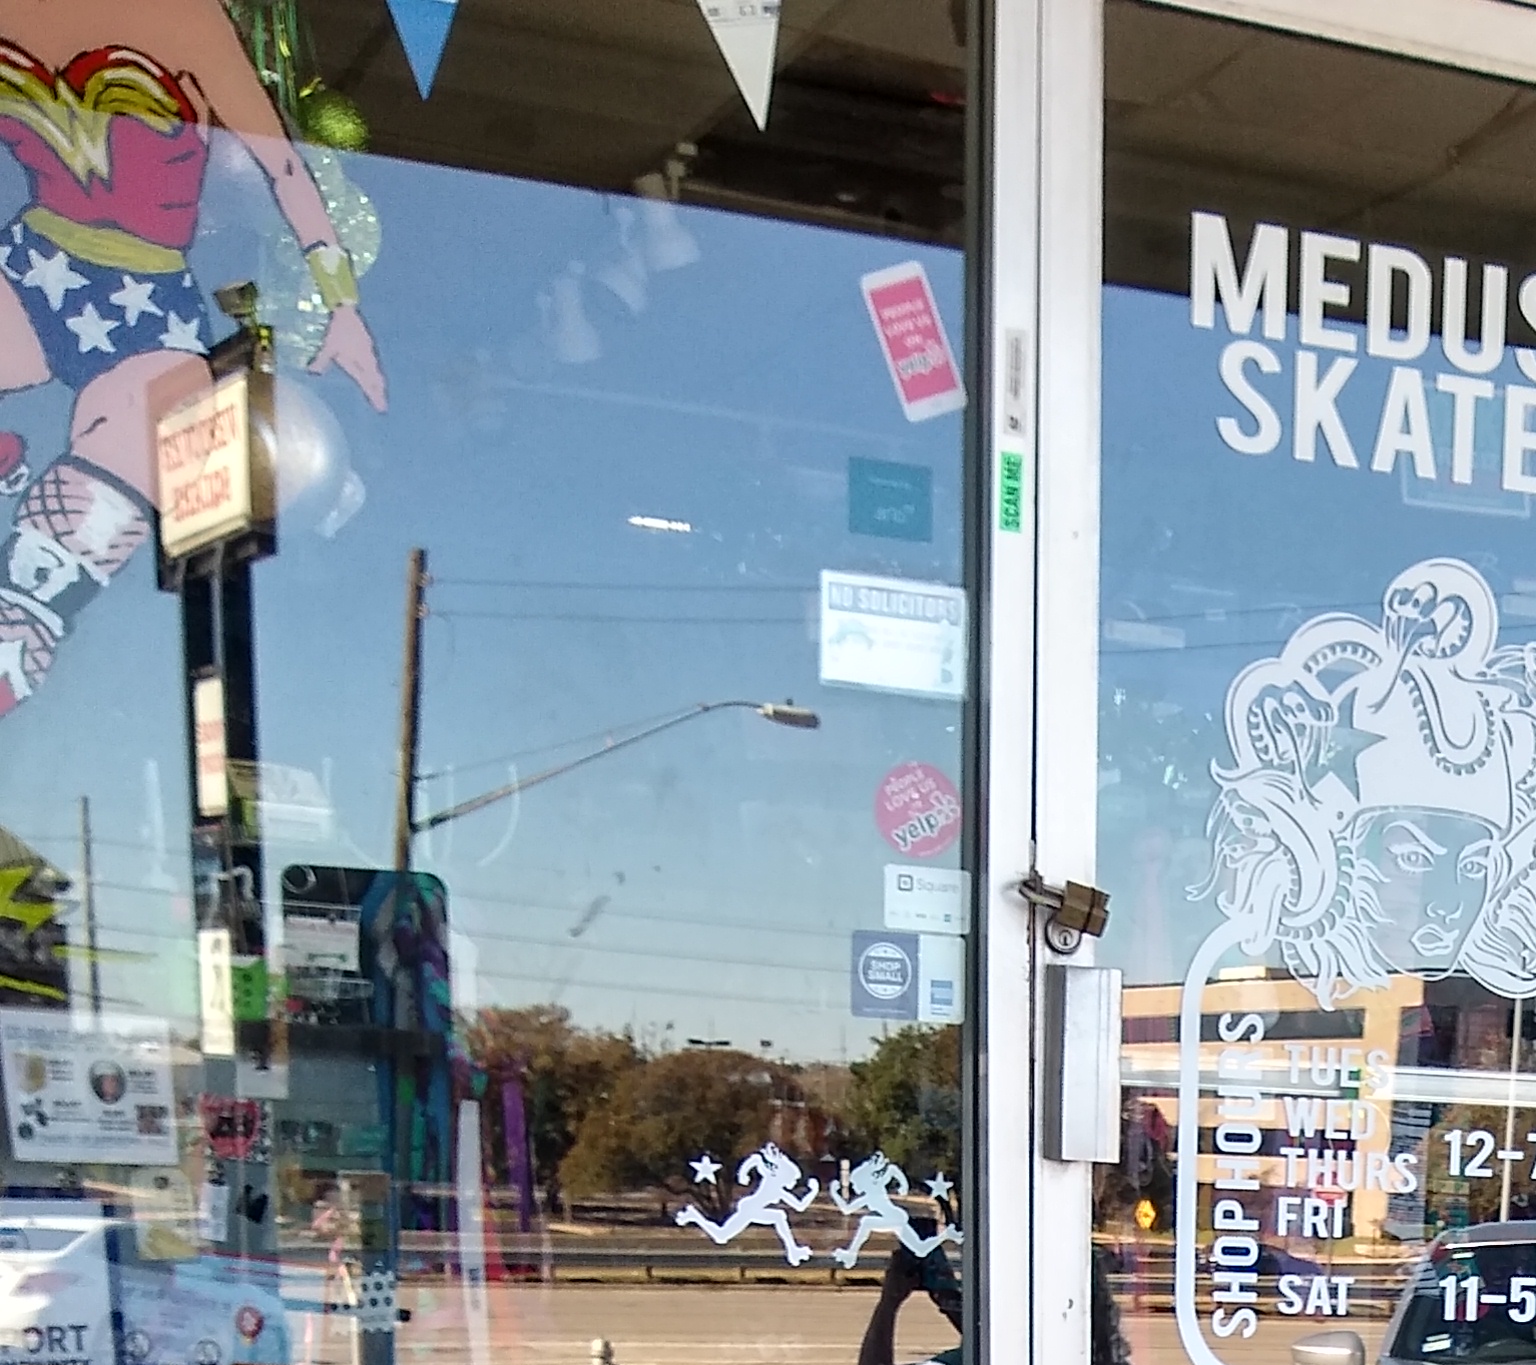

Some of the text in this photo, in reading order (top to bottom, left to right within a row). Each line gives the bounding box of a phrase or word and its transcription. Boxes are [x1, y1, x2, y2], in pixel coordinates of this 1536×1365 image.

[831, 586, 958, 621] NO SOLICITORS
[893, 813, 939, 849] yelp
[867, 969, 904, 984] SMALL
[870, 960, 901, 972] SHOP
[1283, 1043, 1392, 1093] TUES
[1283, 1096, 1377, 1142] WED
[1211, 1012, 1265, 1340] SHOP HOURS
[1280, 1147, 1420, 1195] THURS
[1276, 1195, 1347, 1241] FRI
[1275, 1273, 1355, 1318] SAT
